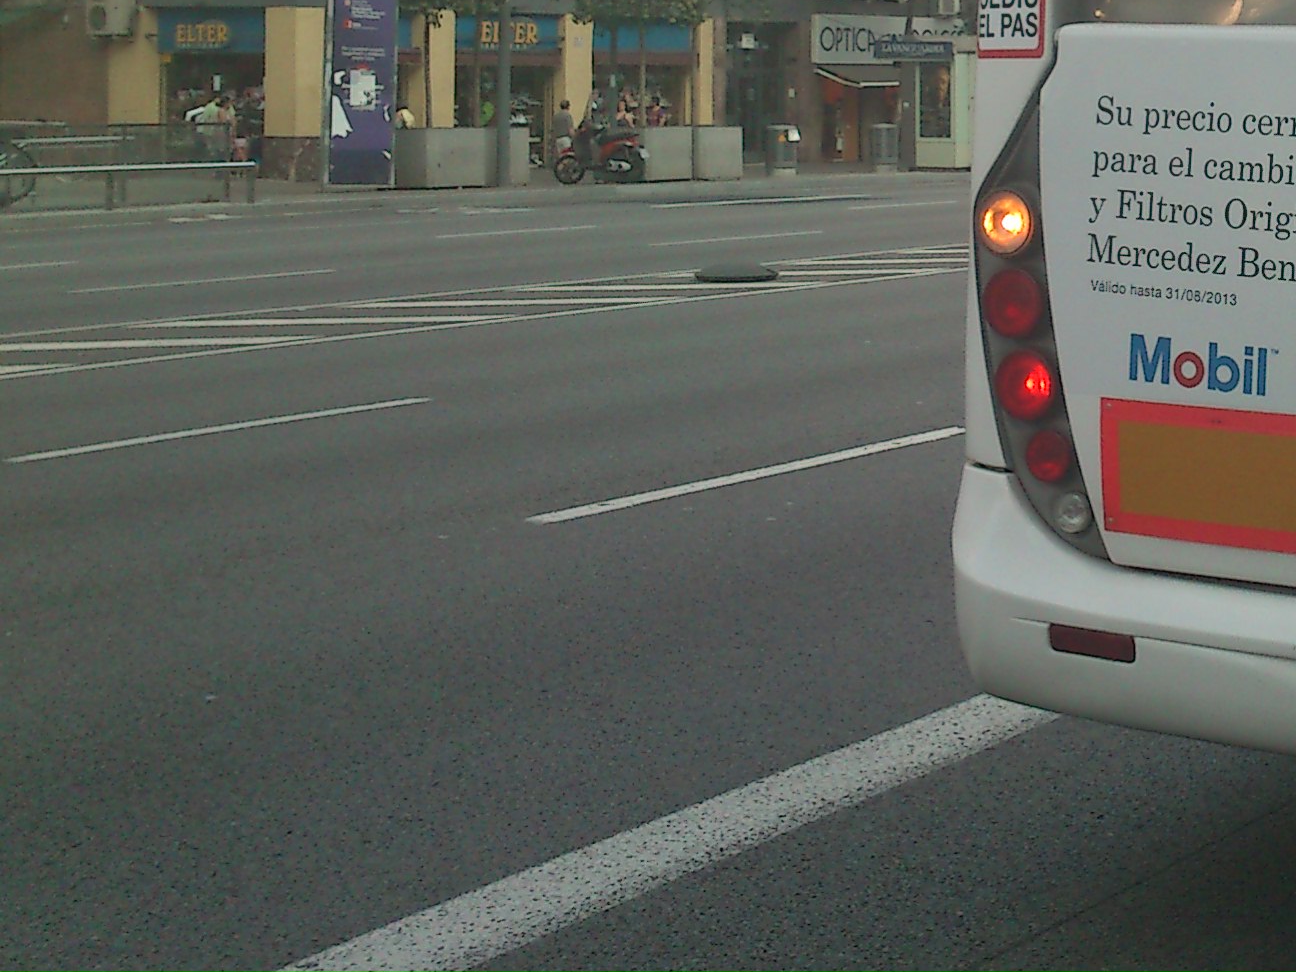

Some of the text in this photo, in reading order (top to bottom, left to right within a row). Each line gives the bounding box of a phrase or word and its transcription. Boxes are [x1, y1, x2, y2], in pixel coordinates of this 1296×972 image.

[175, 24, 229, 43] ELTER
[979, 12, 1038, 38] EL PAS
[1096, 95, 1132, 127] Su
[1142, 101, 1233, 135] precio
[1091, 149, 1158, 178] para
[1168, 147, 1194, 178] el
[1087, 195, 1107, 223] y
[1115, 188, 1213, 227] Filtros
[1086, 232, 1228, 276] Mercedez
[1130, 284, 1162, 299] hasta
